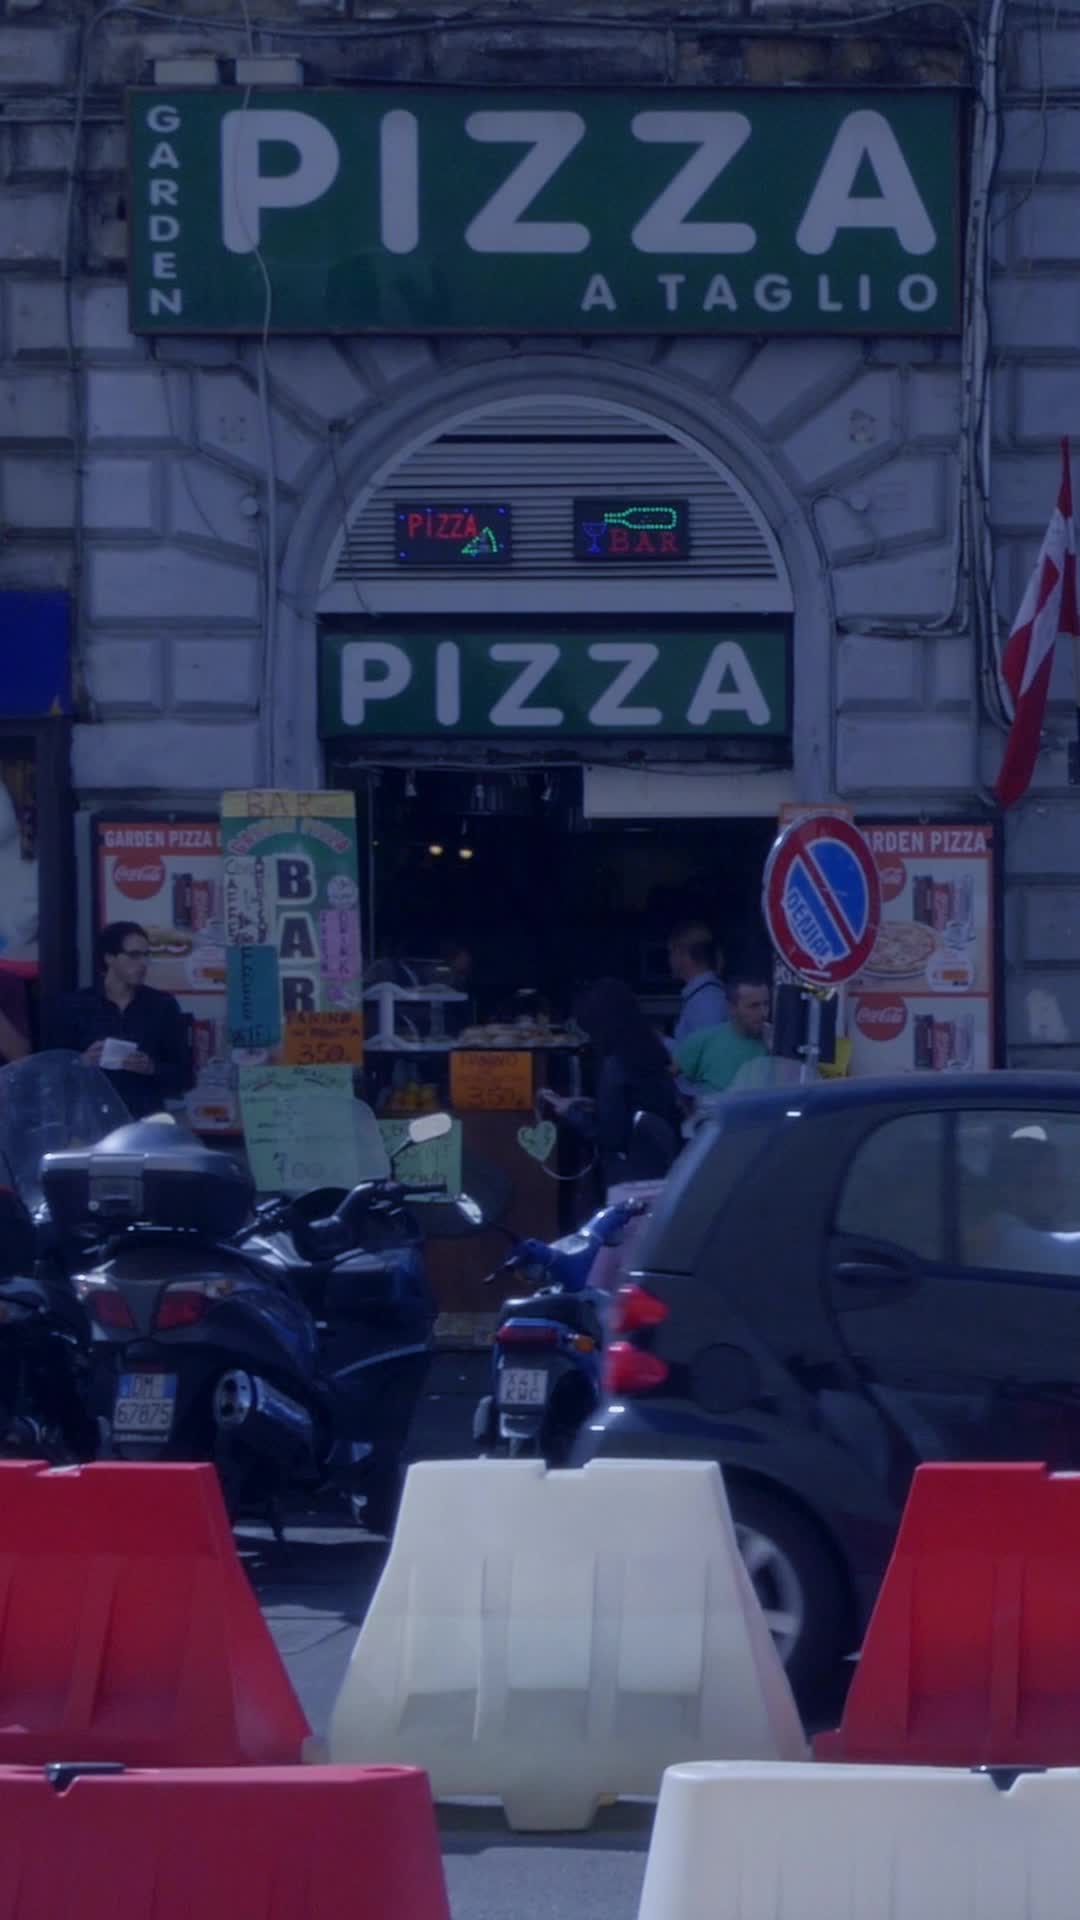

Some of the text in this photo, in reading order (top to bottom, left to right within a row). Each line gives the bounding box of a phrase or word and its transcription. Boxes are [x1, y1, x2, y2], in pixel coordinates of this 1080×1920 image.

[220, 109, 938, 254] PIZZA
[147, 104, 183, 317] GARDEN
[581, 273, 938, 312] A TAGLIO
[407, 512, 477, 539] PIZZA
[607, 527, 679, 553] BAR
[340, 641, 771, 726] PIZZA
[104, 830, 164, 848] GARDEN
[168, 830, 212, 848] PIZZA
[863, 831, 986, 852] ARDEN PIZZA
[276, 857, 318, 1012] BAR
